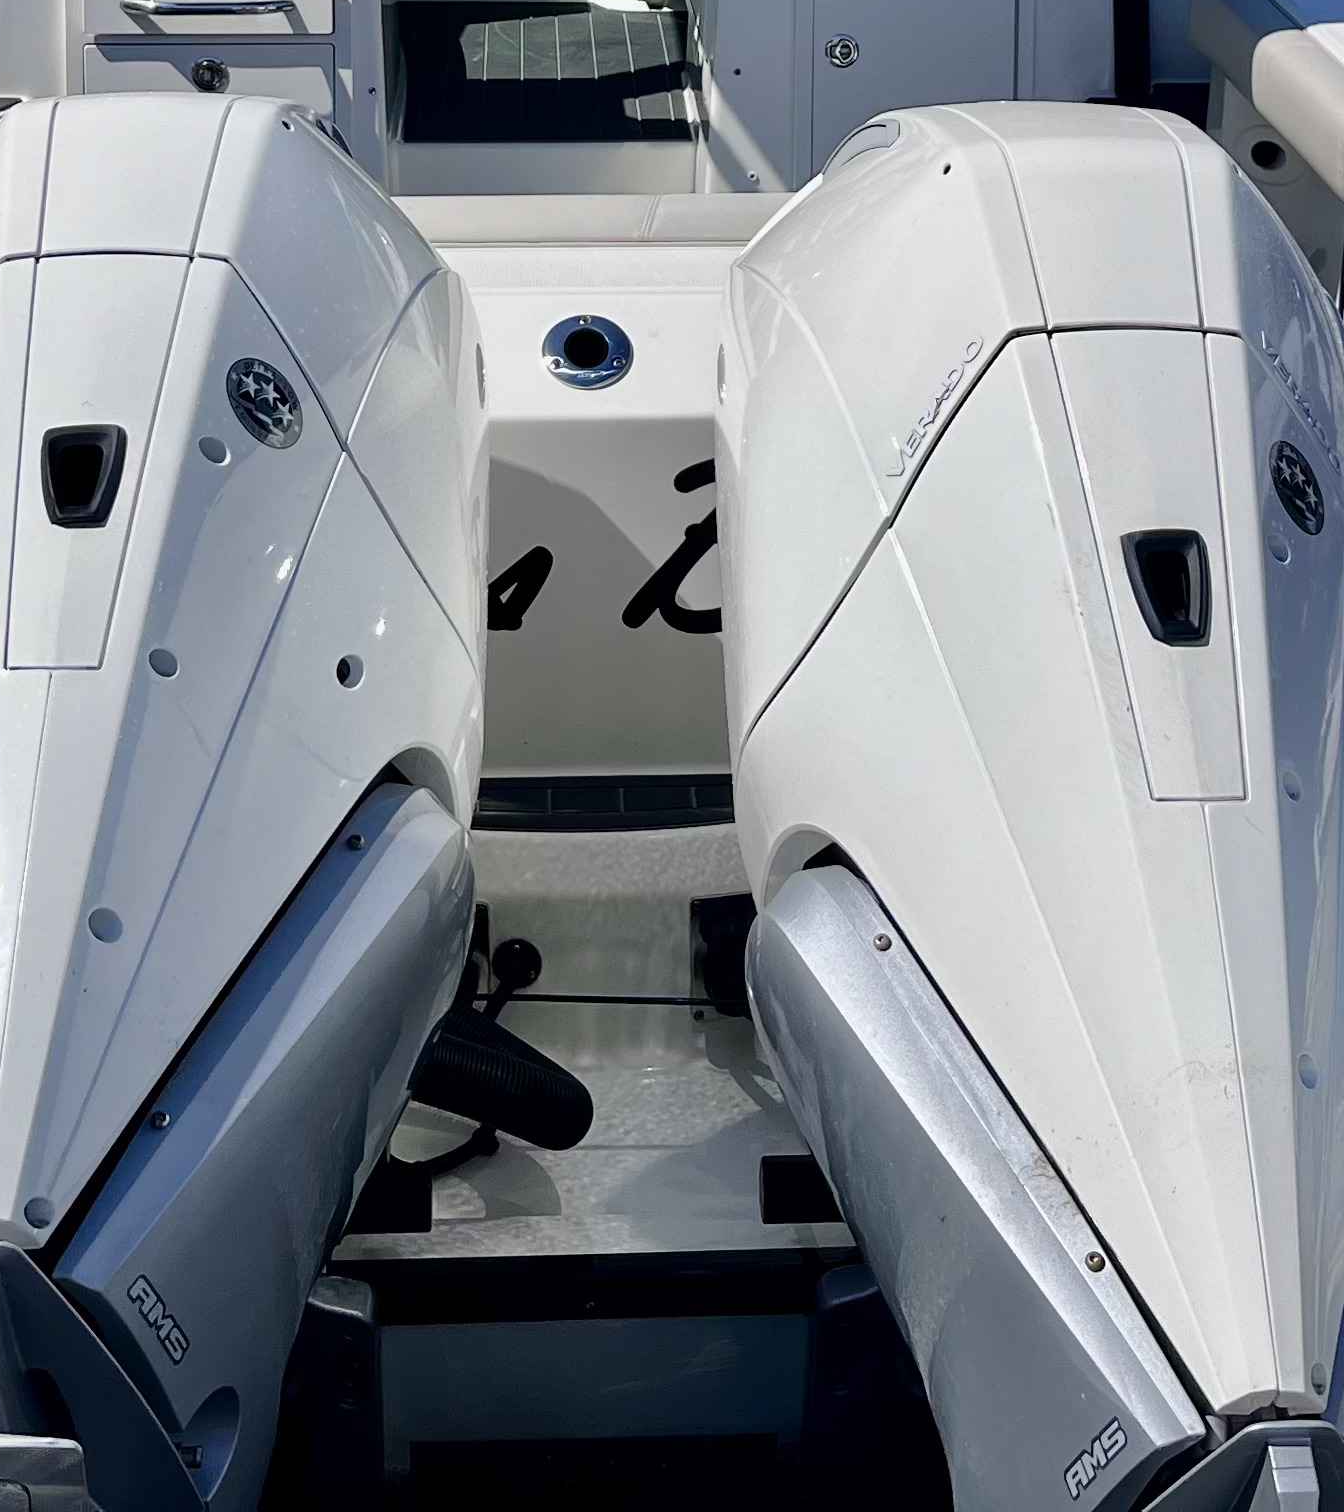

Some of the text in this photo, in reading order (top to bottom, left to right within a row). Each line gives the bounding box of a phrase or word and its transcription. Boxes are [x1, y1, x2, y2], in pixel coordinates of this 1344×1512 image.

[885, 336, 985, 478] VERADO
[127, 1273, 191, 1366] AMS
[1063, 1414, 1128, 1502] AMS
